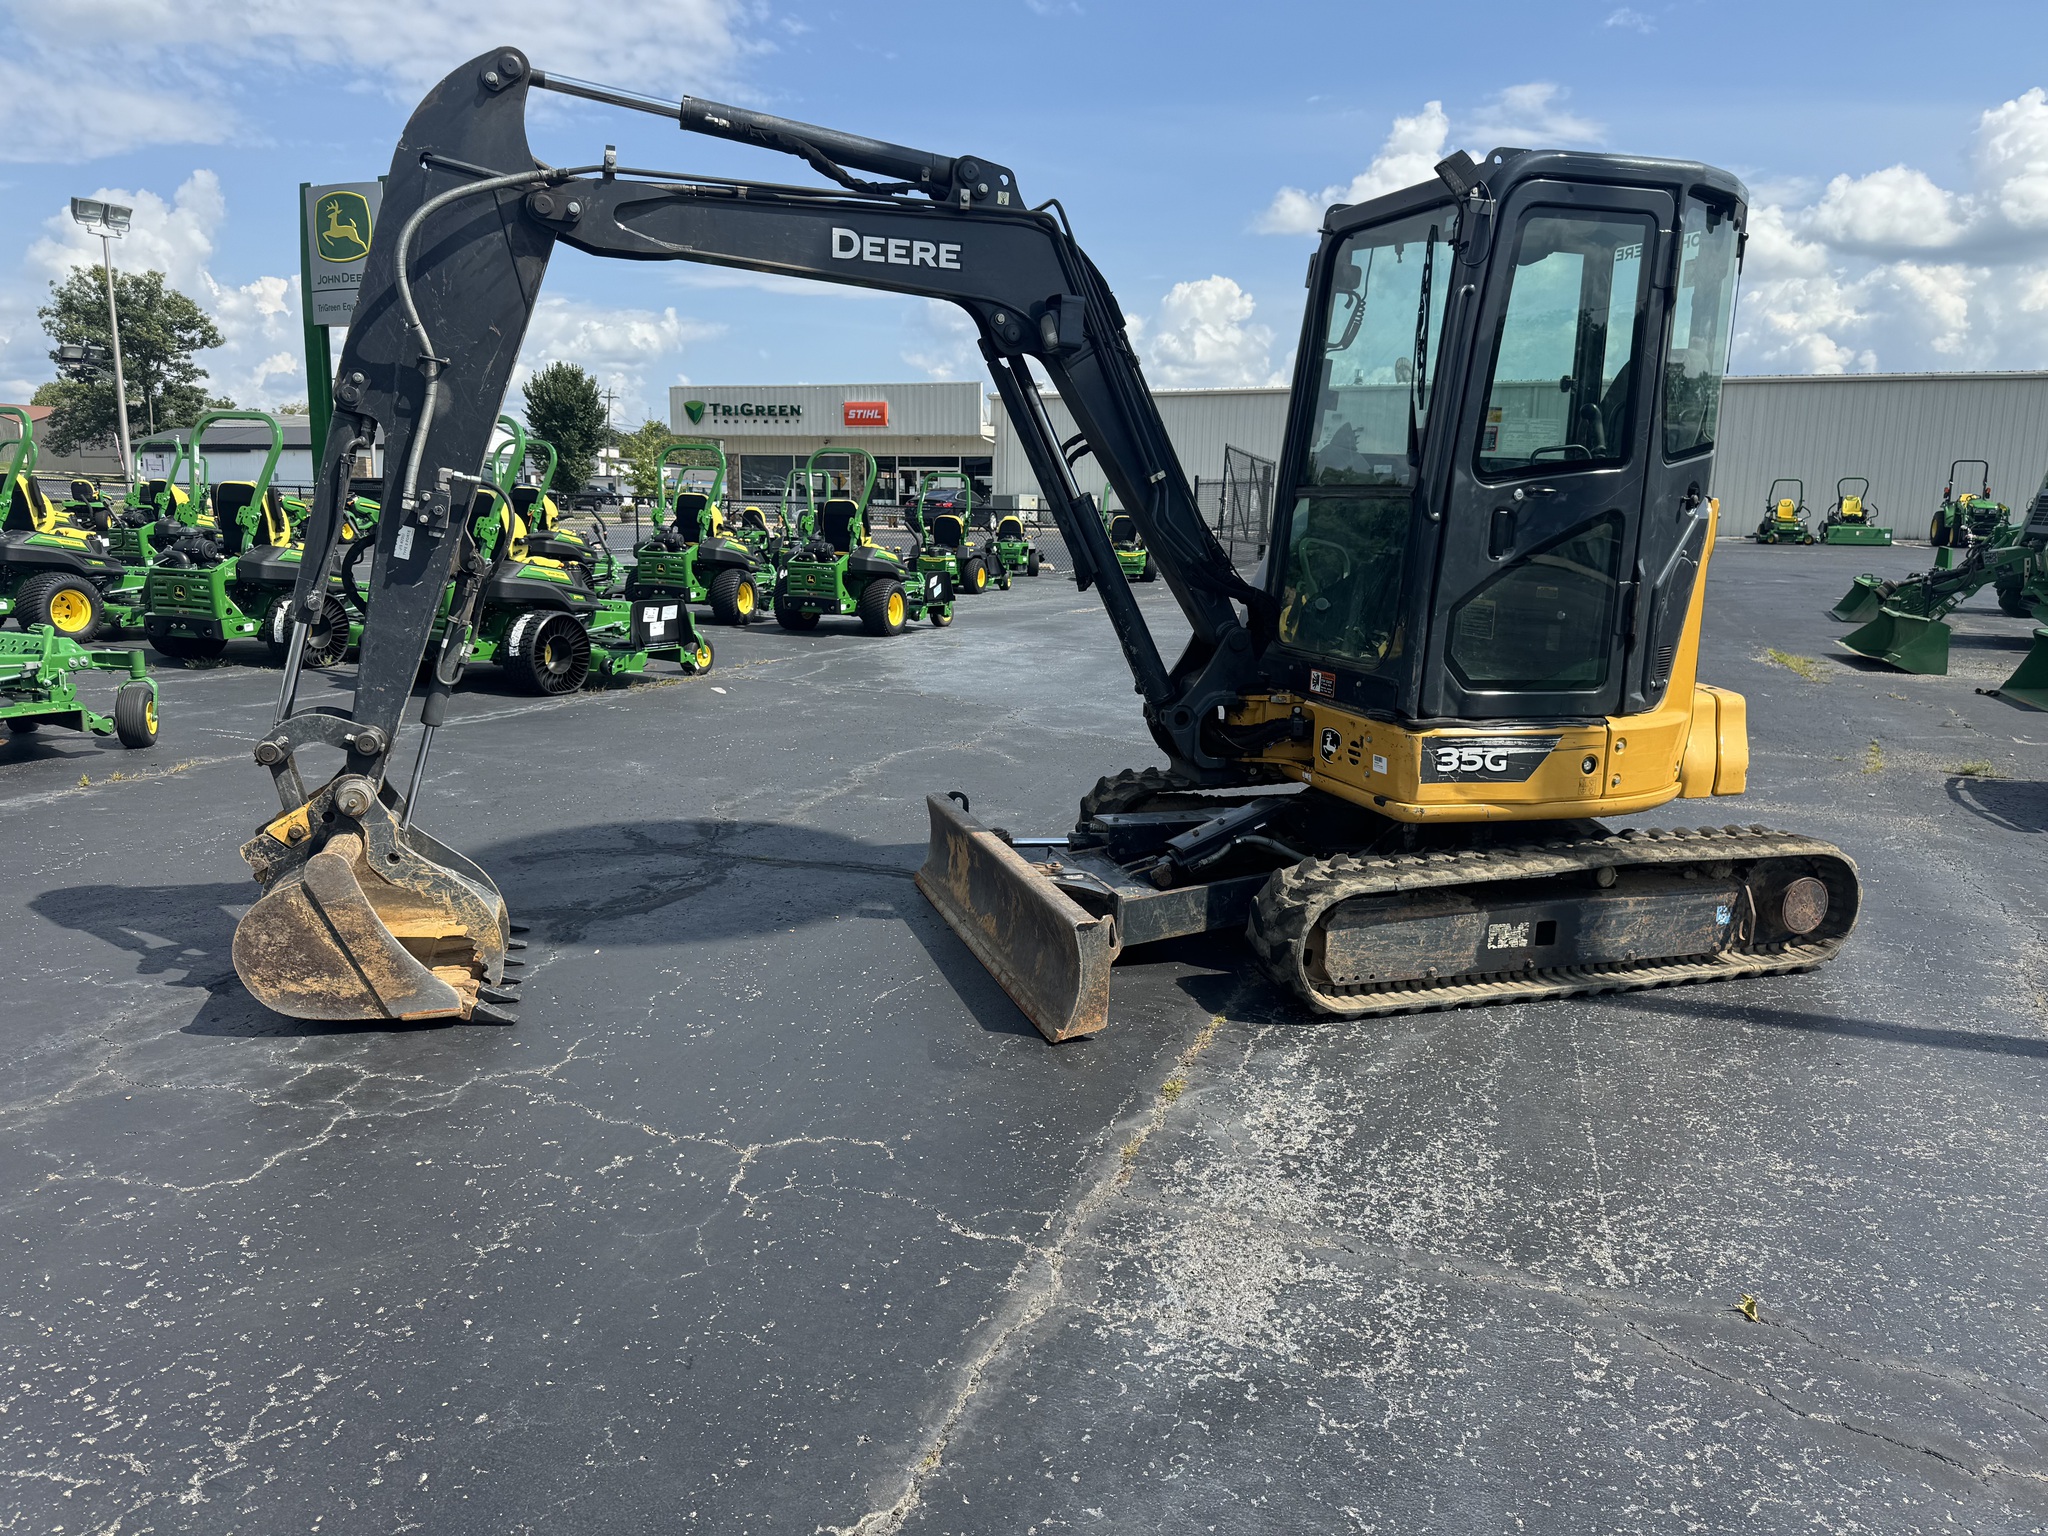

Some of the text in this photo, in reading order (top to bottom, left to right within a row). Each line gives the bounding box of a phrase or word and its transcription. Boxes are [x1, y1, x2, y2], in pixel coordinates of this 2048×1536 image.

[832, 227, 961, 270] DEERE
[317, 272, 362, 285] JOHN DEE
[317, 303, 341, 312] TriGreen
[847, 409, 882, 419] STIHL
[1436, 747, 1508, 772] 35G
